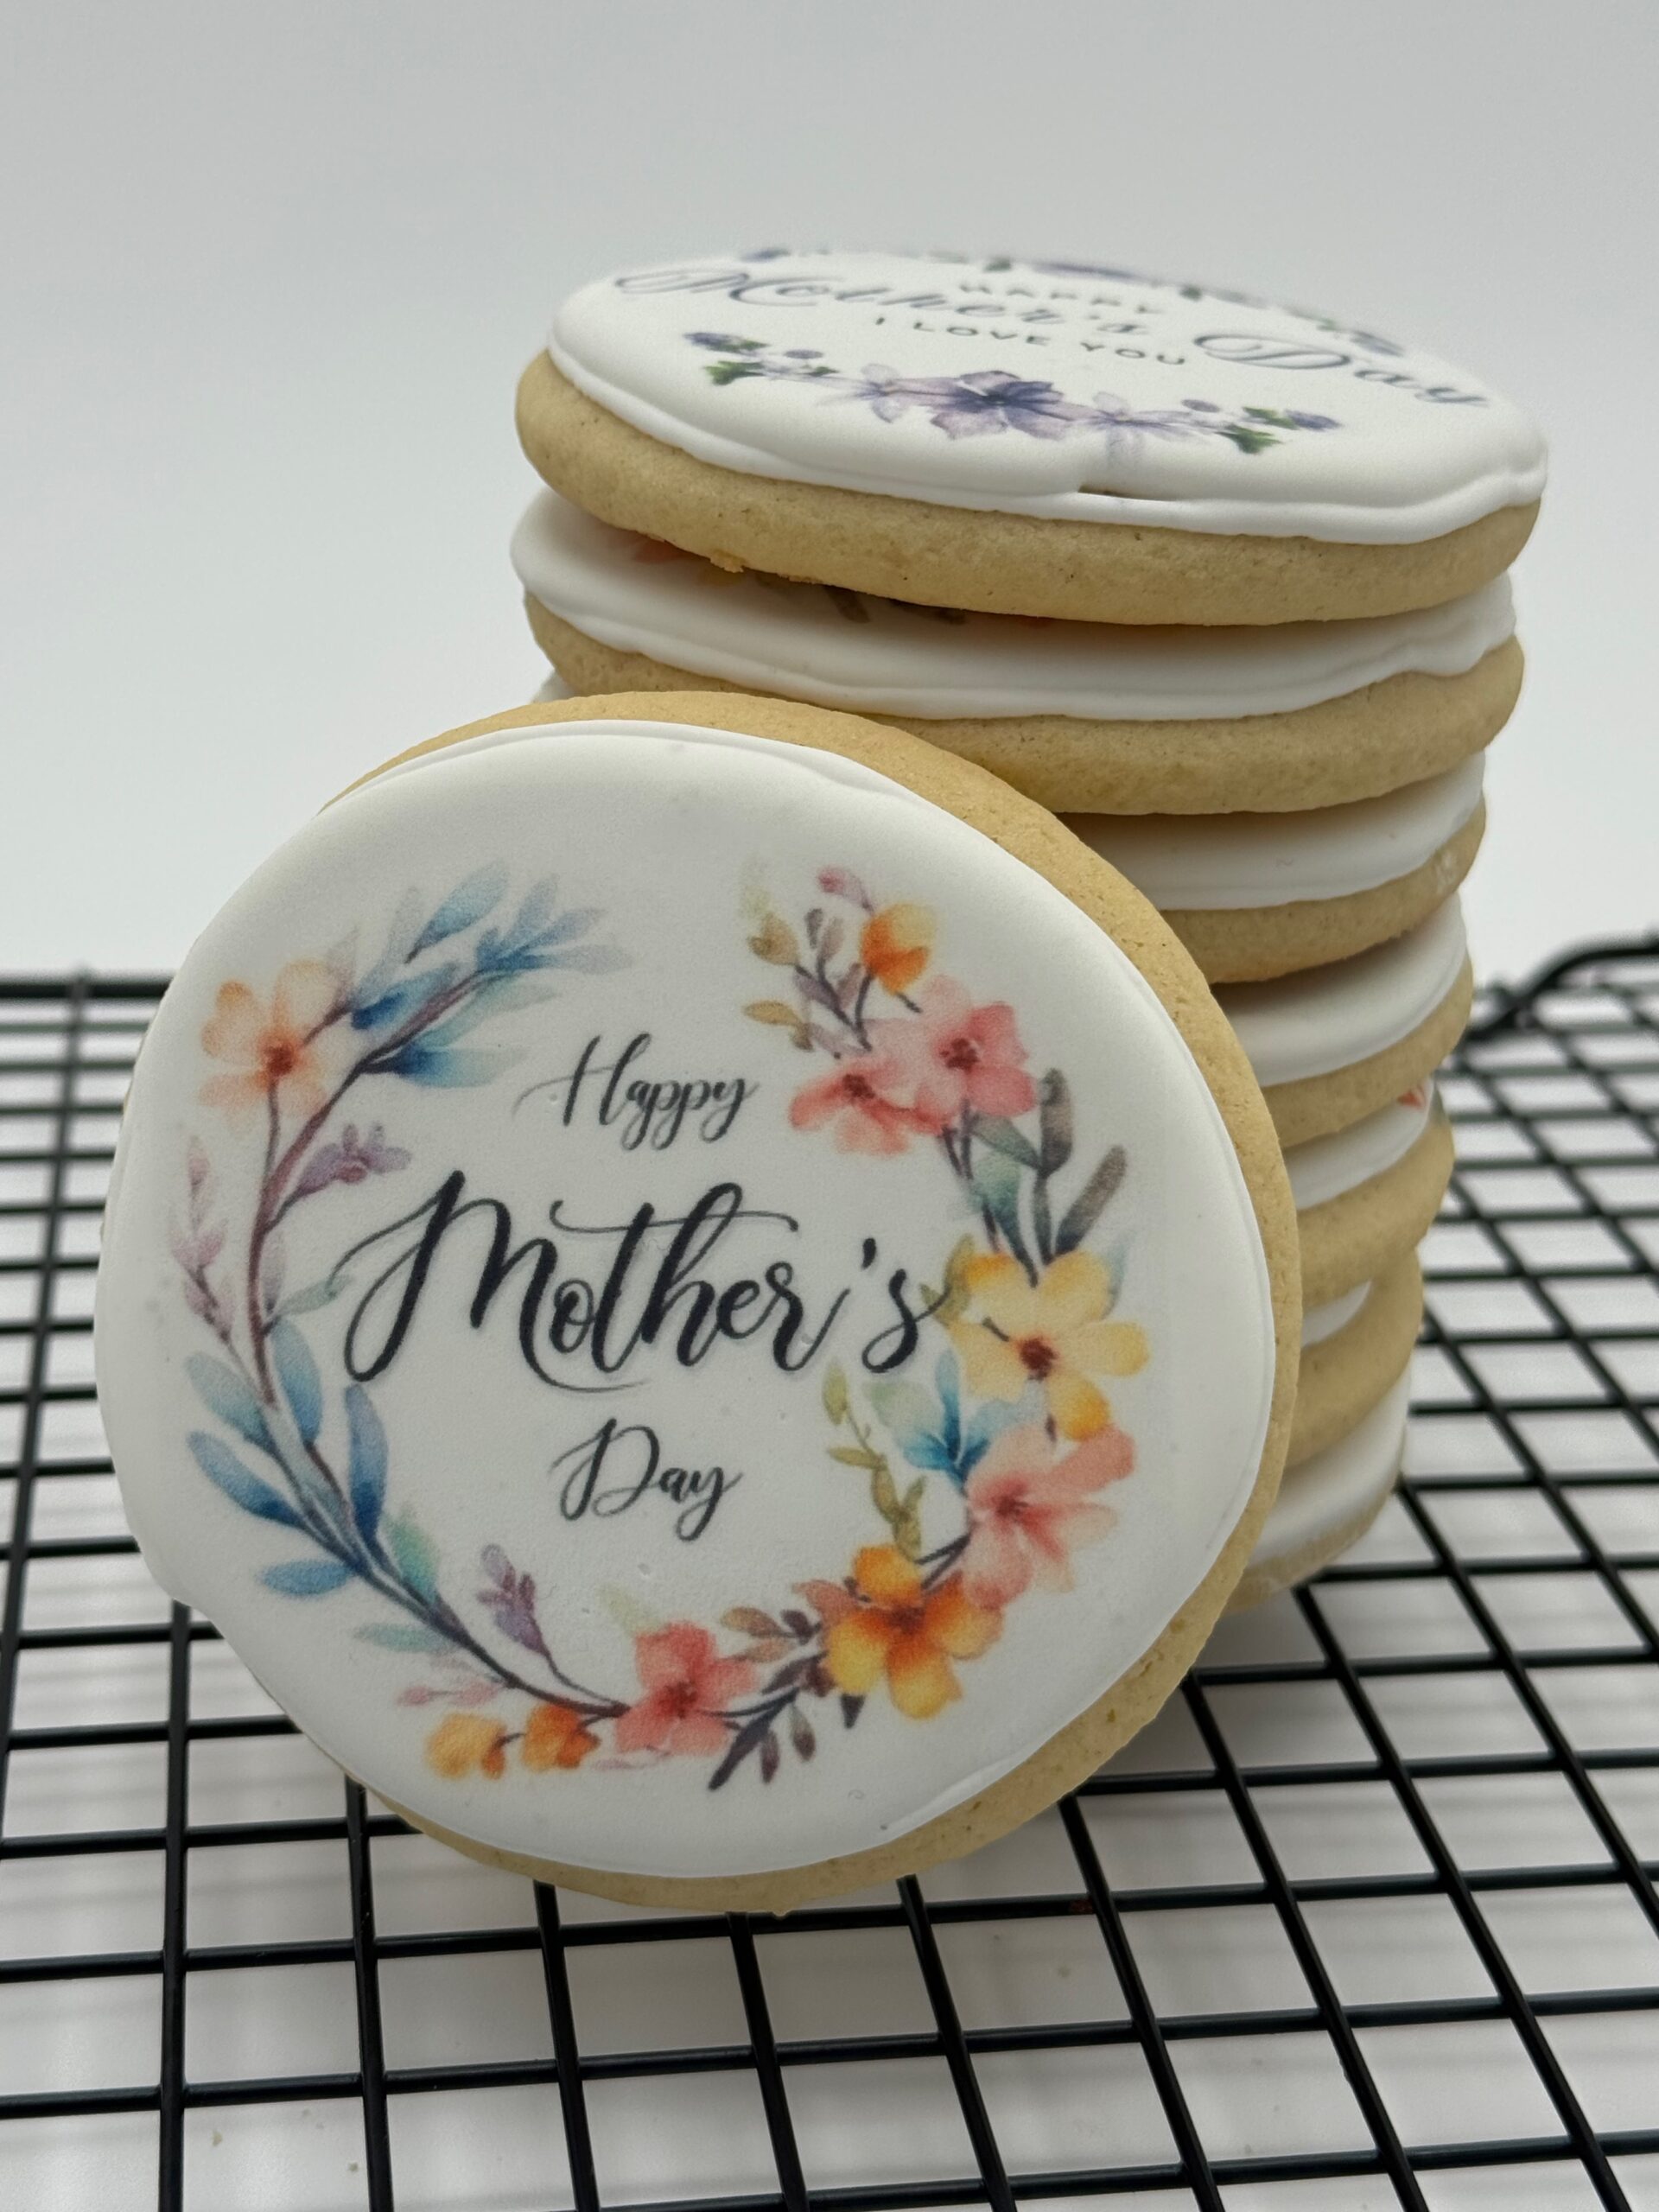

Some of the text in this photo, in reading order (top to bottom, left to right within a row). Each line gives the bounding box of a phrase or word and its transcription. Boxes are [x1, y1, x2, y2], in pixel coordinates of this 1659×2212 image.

[912, 321, 1052, 346] LOVE
[1079, 340, 1185, 365] YOU
[1193, 333, 1488, 406] Day
[512, 1033, 758, 1151] Happy
[328, 1169, 950, 1394] Mother's
[550, 1417, 743, 1541] Day
